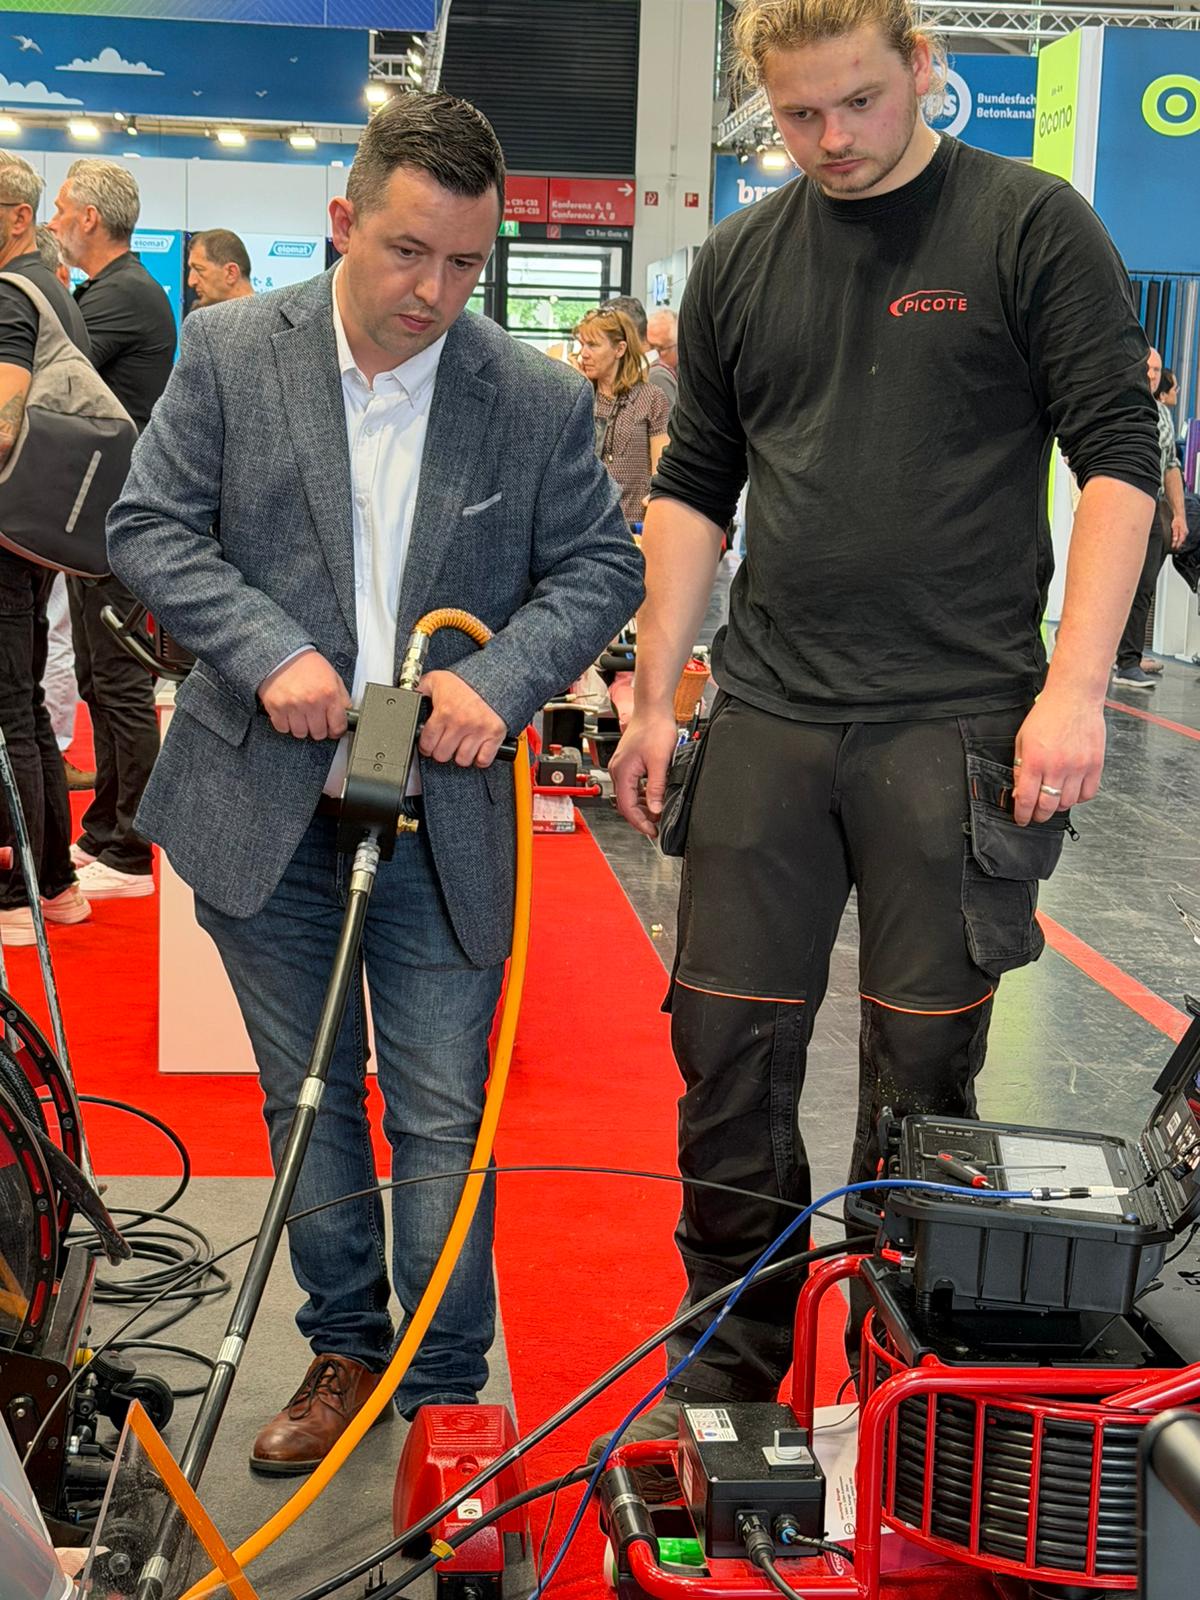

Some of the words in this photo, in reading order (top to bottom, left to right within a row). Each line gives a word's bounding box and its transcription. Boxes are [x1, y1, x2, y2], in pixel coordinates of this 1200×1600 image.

[977, 93, 1036, 105] Bundesfach
[552, 210, 595, 220] Conference
[265, 277, 273, 287] &
[904, 298, 968, 312] PICOTE
